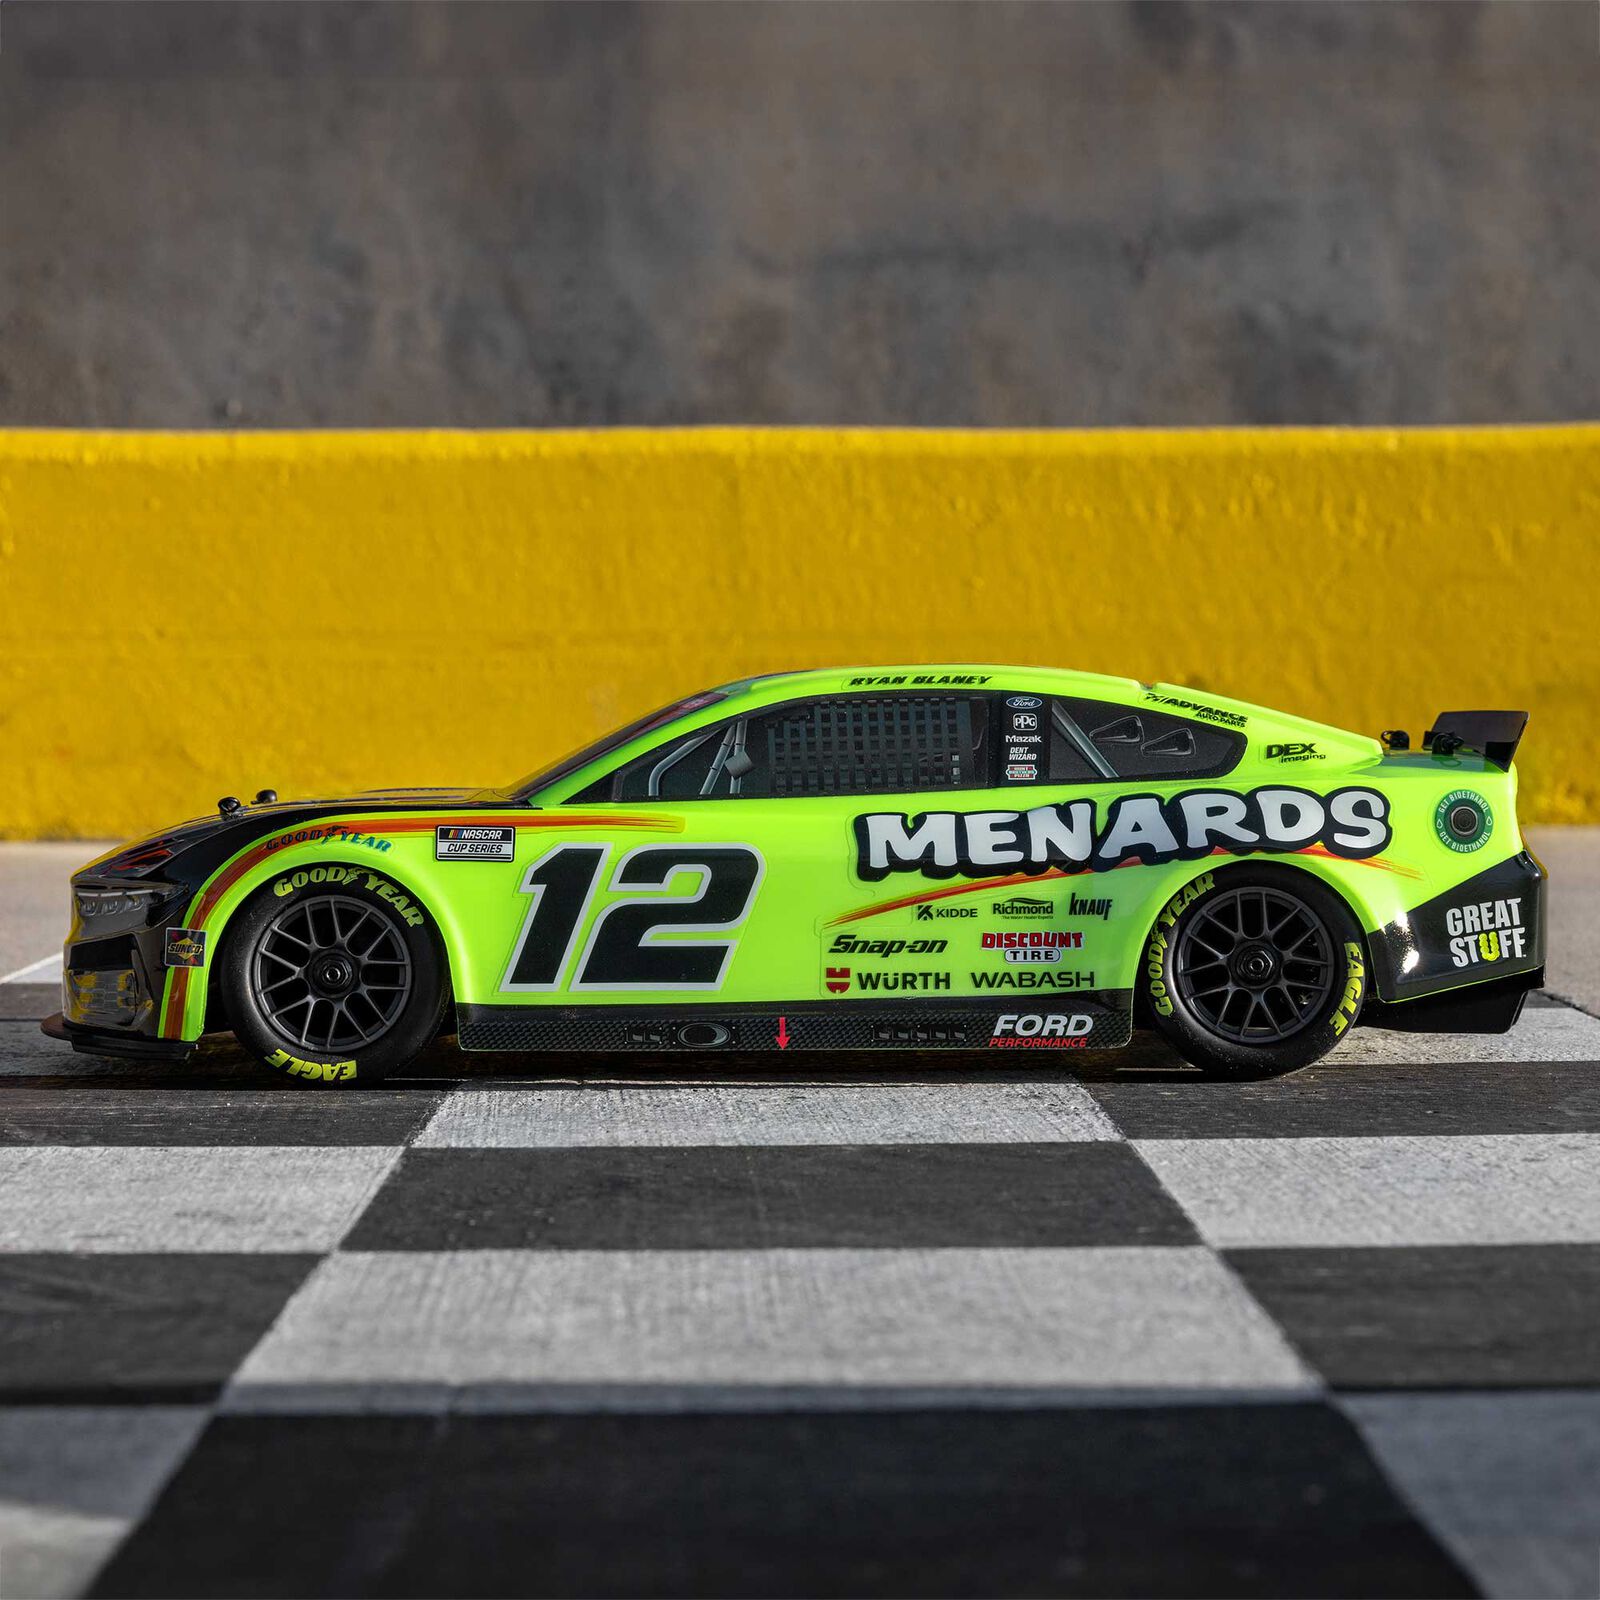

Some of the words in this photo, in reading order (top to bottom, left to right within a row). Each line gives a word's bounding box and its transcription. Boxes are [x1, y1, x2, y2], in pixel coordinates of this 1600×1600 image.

[849, 676, 908, 686] RYAN
[910, 676, 992, 685] BLANEY
[1013, 699, 1035, 707] Ford
[1163, 697, 1248, 722] ADVANCE
[1015, 716, 1035, 728] PPG
[1196, 712, 1218, 721] AUTO
[1220, 718, 1246, 728] PARTS
[1005, 735, 1042, 743] Mazak
[1266, 743, 1317, 759] DEX
[1280, 753, 1326, 763] imaging
[1439, 799, 1449, 813] GET
[1448, 790, 1489, 813] BIOETHANOL
[461, 829, 503, 840] NASCAR
[860, 786, 1391, 877] MENARDS
[447, 843, 468, 853] CUP
[468, 844, 503, 853] SERIES
[1440, 831, 1452, 845] GET
[1451, 831, 1491, 852] BIOETHANOL
[936, 908, 978, 918] KIDDE
[992, 901, 1054, 915] Richmond
[499, 842, 766, 992] 12
[1446, 897, 1522, 937] GREAT
[828, 934, 949, 958] Snap-on
[981, 931, 1083, 949] DISCOUNT
[1449, 927, 1526, 967] STUFF
[1009, 950, 1055, 961] TIRE
[970, 971, 1096, 988] WABASH
[1328, 942, 1365, 1036] EAGLE
[992, 1014, 1094, 1036] FORD
[988, 1037, 1087, 1048] PERFORMANCE
[263, 1048, 358, 1081] EAGLE
